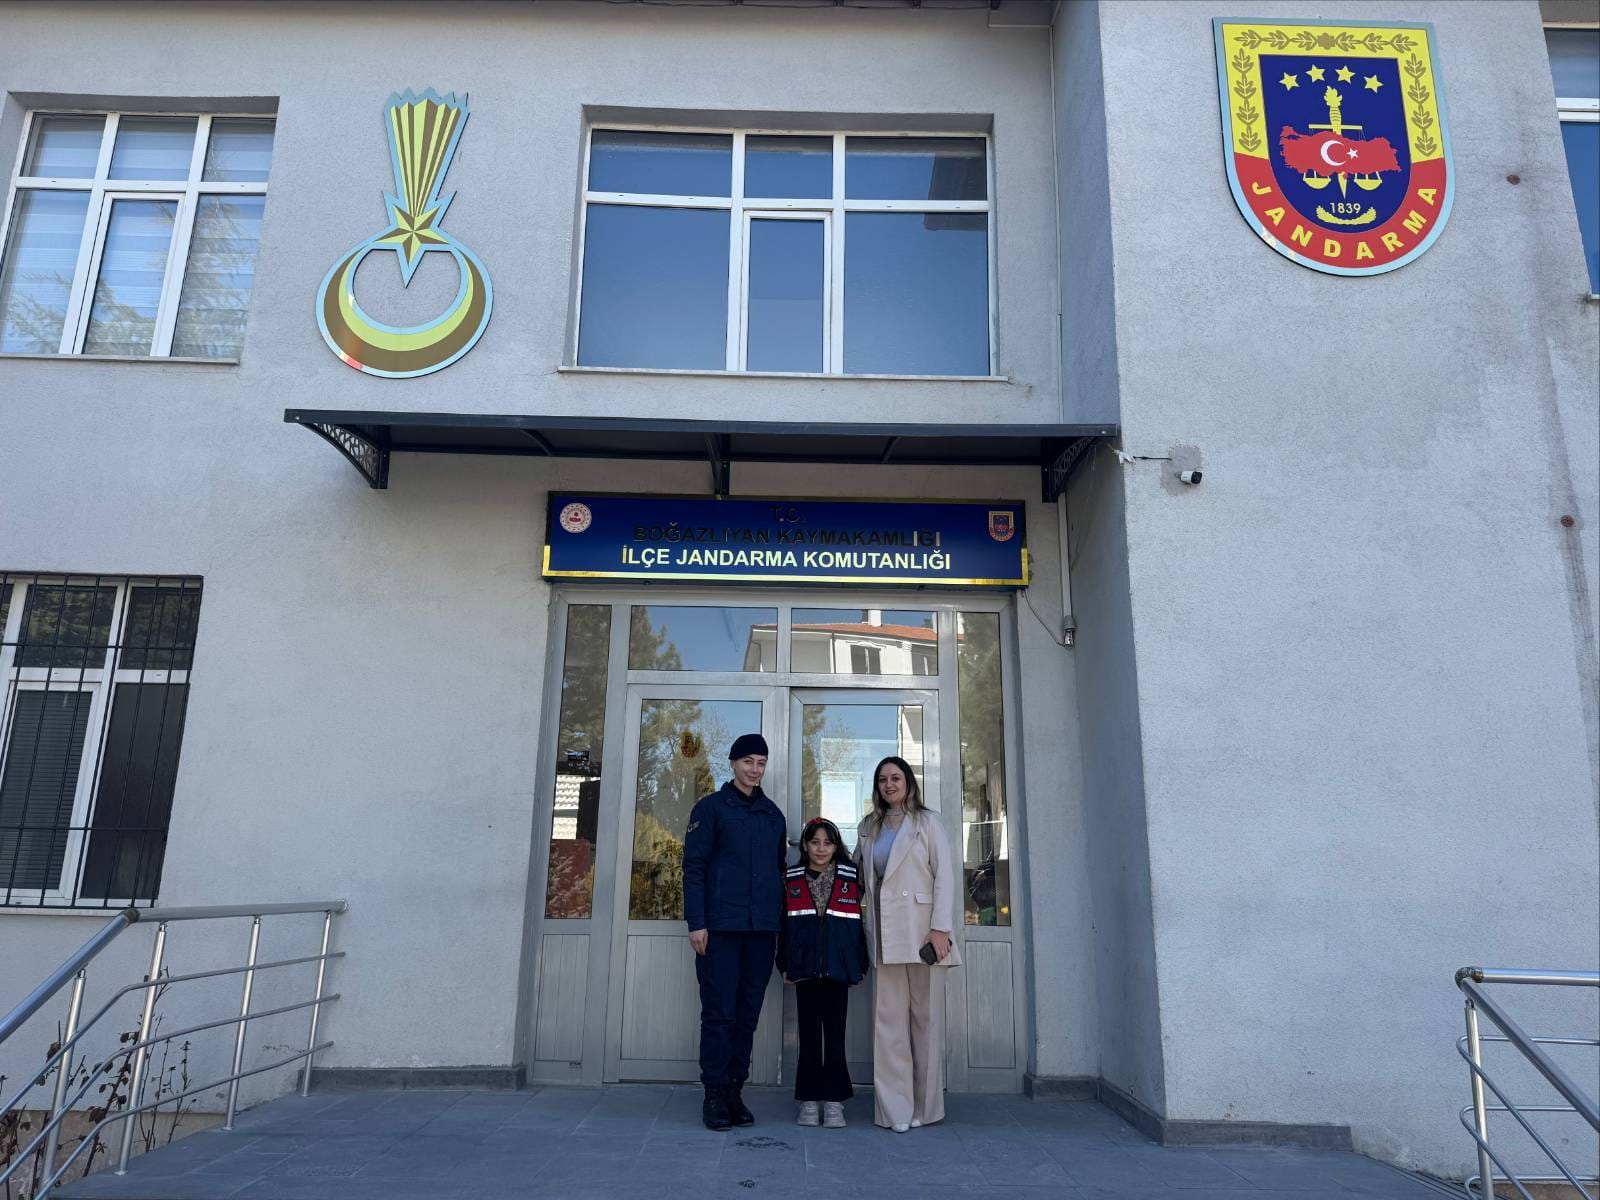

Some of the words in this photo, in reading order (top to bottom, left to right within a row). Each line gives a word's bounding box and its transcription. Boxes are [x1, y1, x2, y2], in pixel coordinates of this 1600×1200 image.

[1251, 181, 1437, 260] JANDARMA
[1330, 202, 1361, 214] 1839
[632, 521, 771, 544] BOĞAZLIYAN
[776, 527, 941, 547] KAYMAKAMLIĞI
[622, 544, 670, 568] İLÇE
[676, 548, 797, 568] JANDARMA
[803, 549, 950, 570] KOMUTANLIĞI
